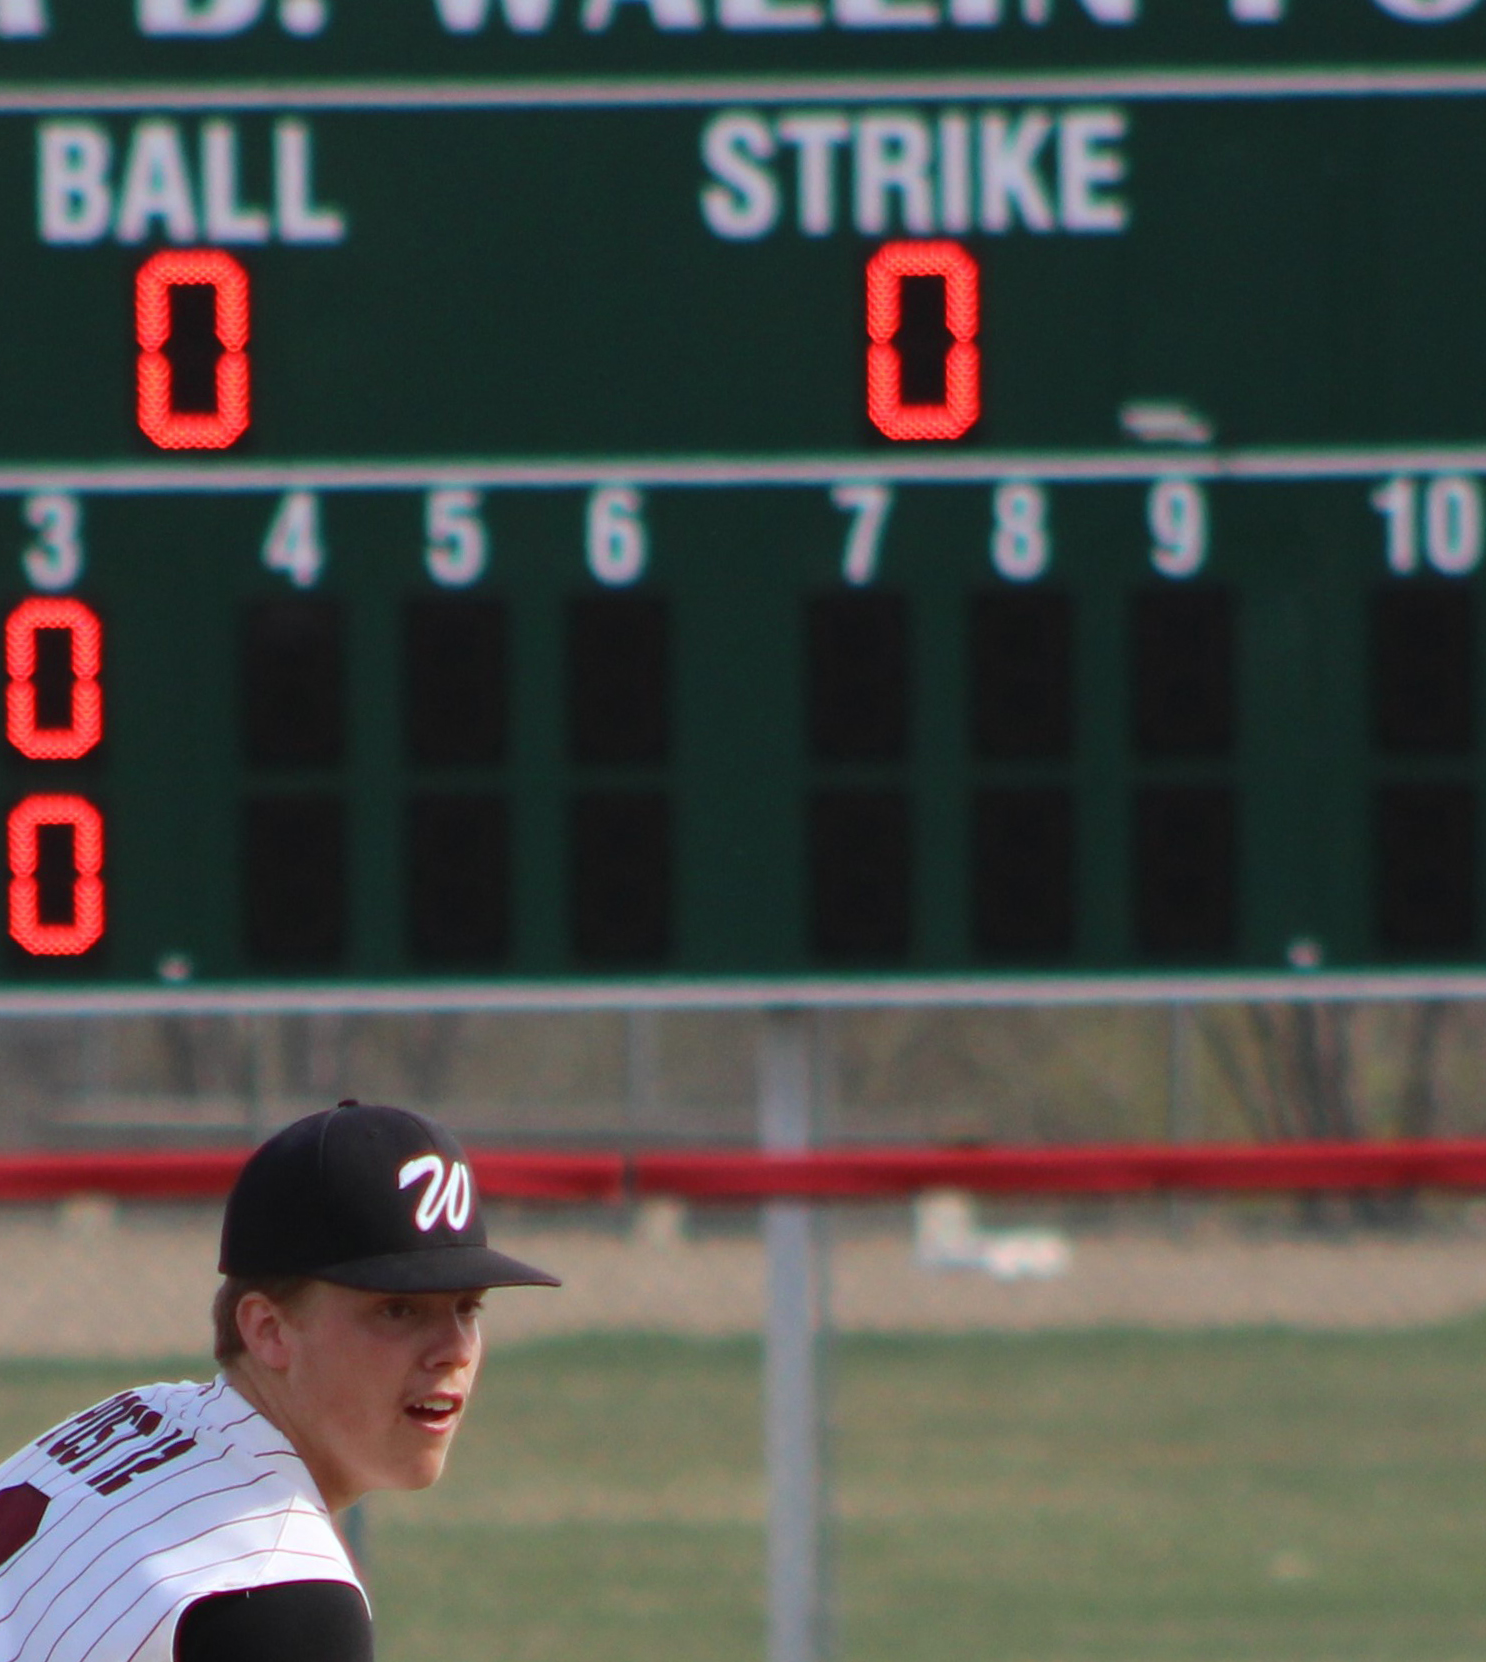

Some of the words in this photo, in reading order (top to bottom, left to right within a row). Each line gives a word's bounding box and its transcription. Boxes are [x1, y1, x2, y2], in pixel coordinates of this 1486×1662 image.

[41, 122, 343, 241] BALL
[704, 111, 1124, 236] STRIKE
[136, 250, 249, 449] 0
[866, 241, 979, 440] 0
[27, 492, 79, 588] 3
[267, 491, 319, 583] 4
[429, 488, 483, 582] 5
[590, 487, 642, 581] 6
[835, 482, 888, 581] 7
[995, 480, 1045, 577] 8
[1152, 480, 1202, 573] 9
[1374, 478, 1480, 571] 10
[5, 598, 102, 760] 0
[8, 794, 104, 955] 0
[397, 1154, 472, 1231] W
